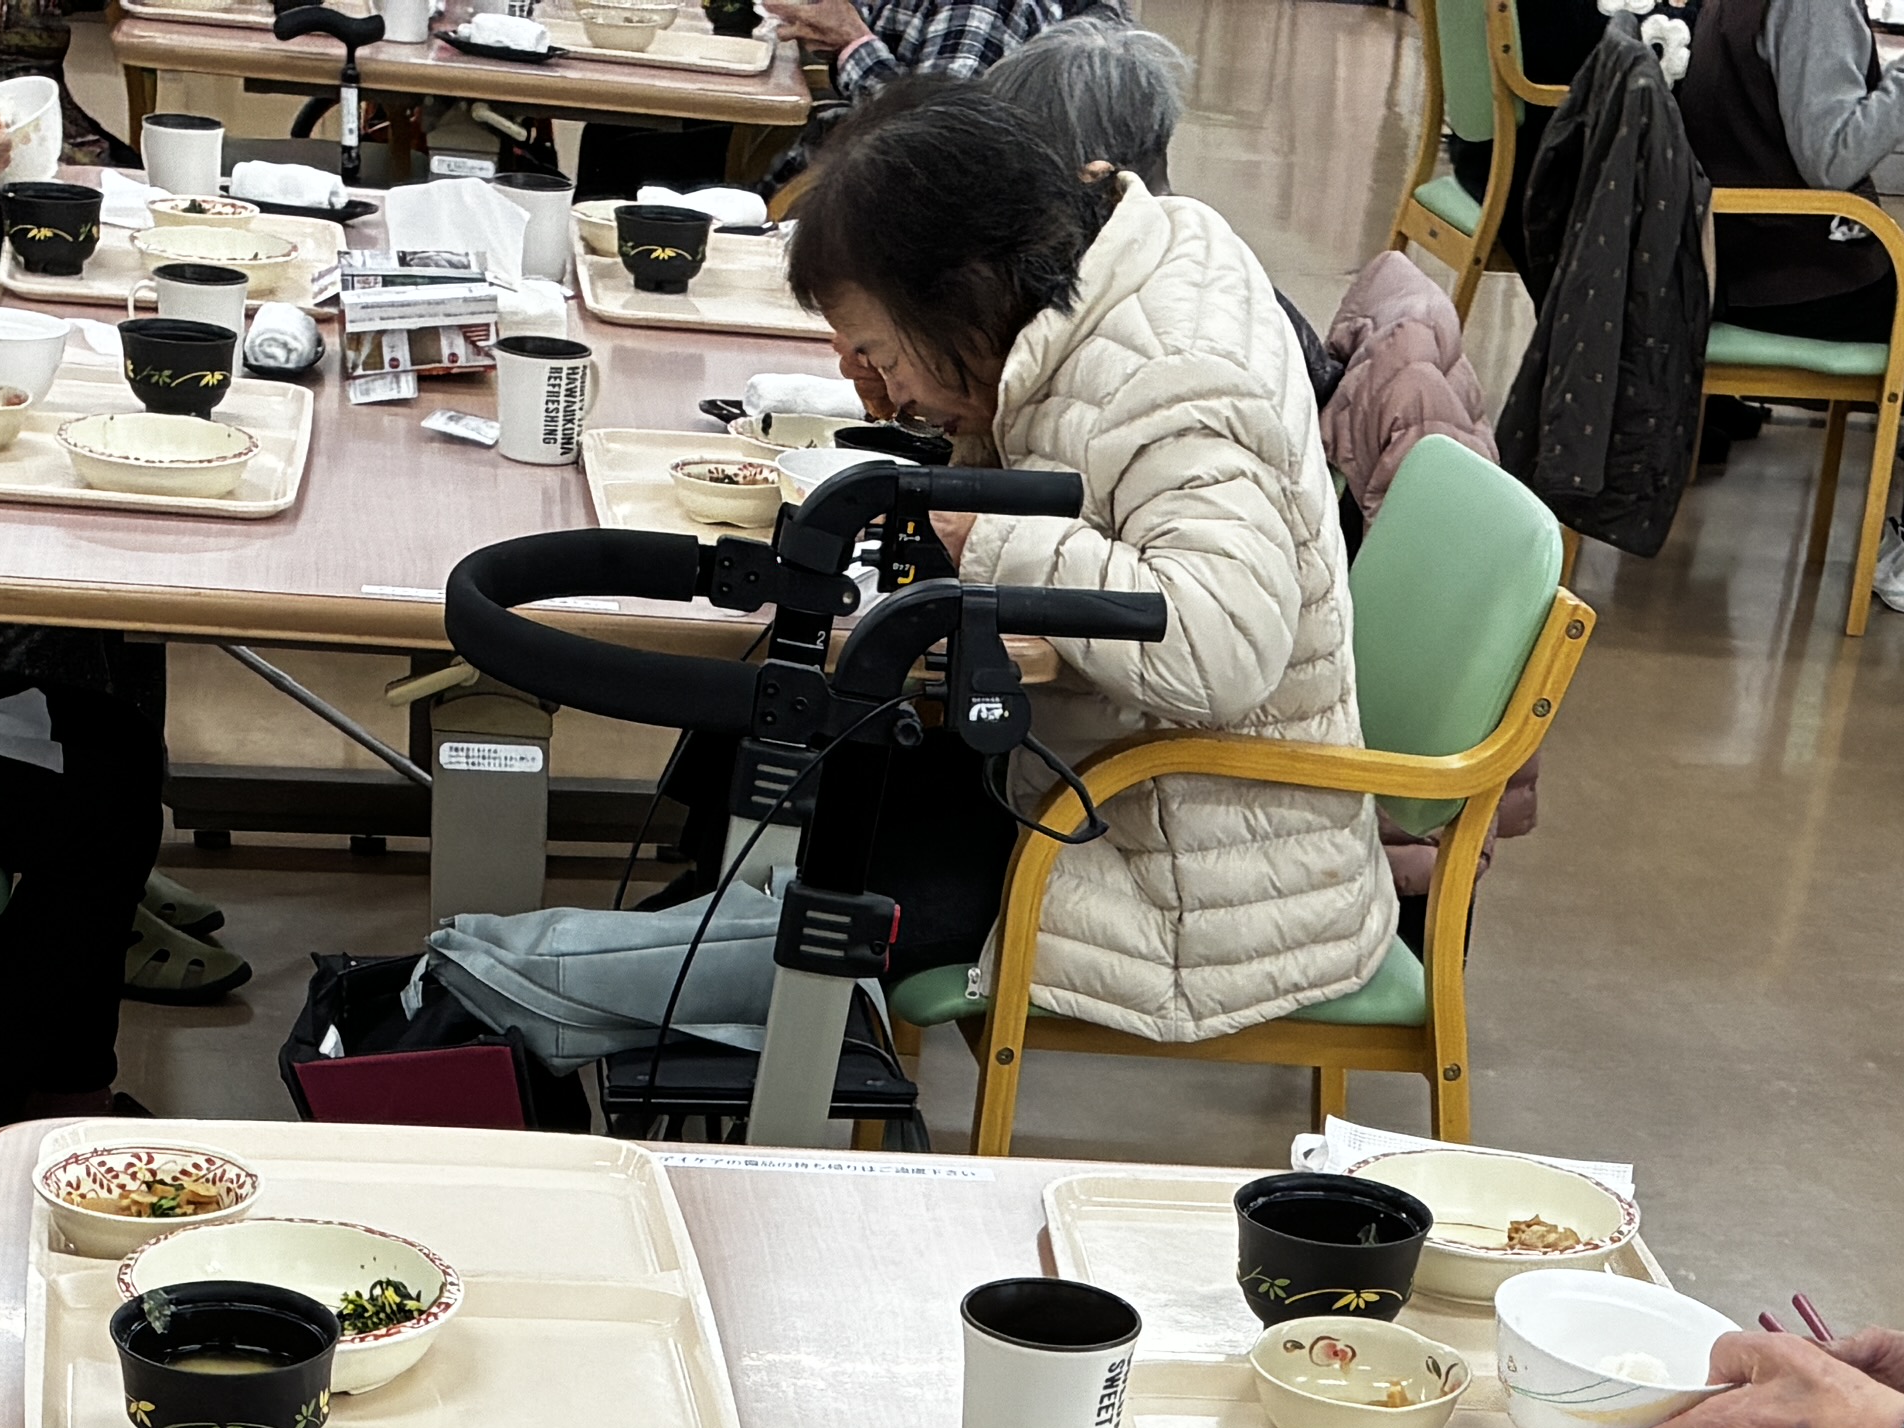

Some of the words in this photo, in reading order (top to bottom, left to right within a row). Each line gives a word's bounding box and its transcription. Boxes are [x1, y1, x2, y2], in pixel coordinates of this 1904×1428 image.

[542, 366, 564, 446] REFRESHING
[816, 630, 826, 645] 2
[1094, 1358, 1126, 1427] SWEET
